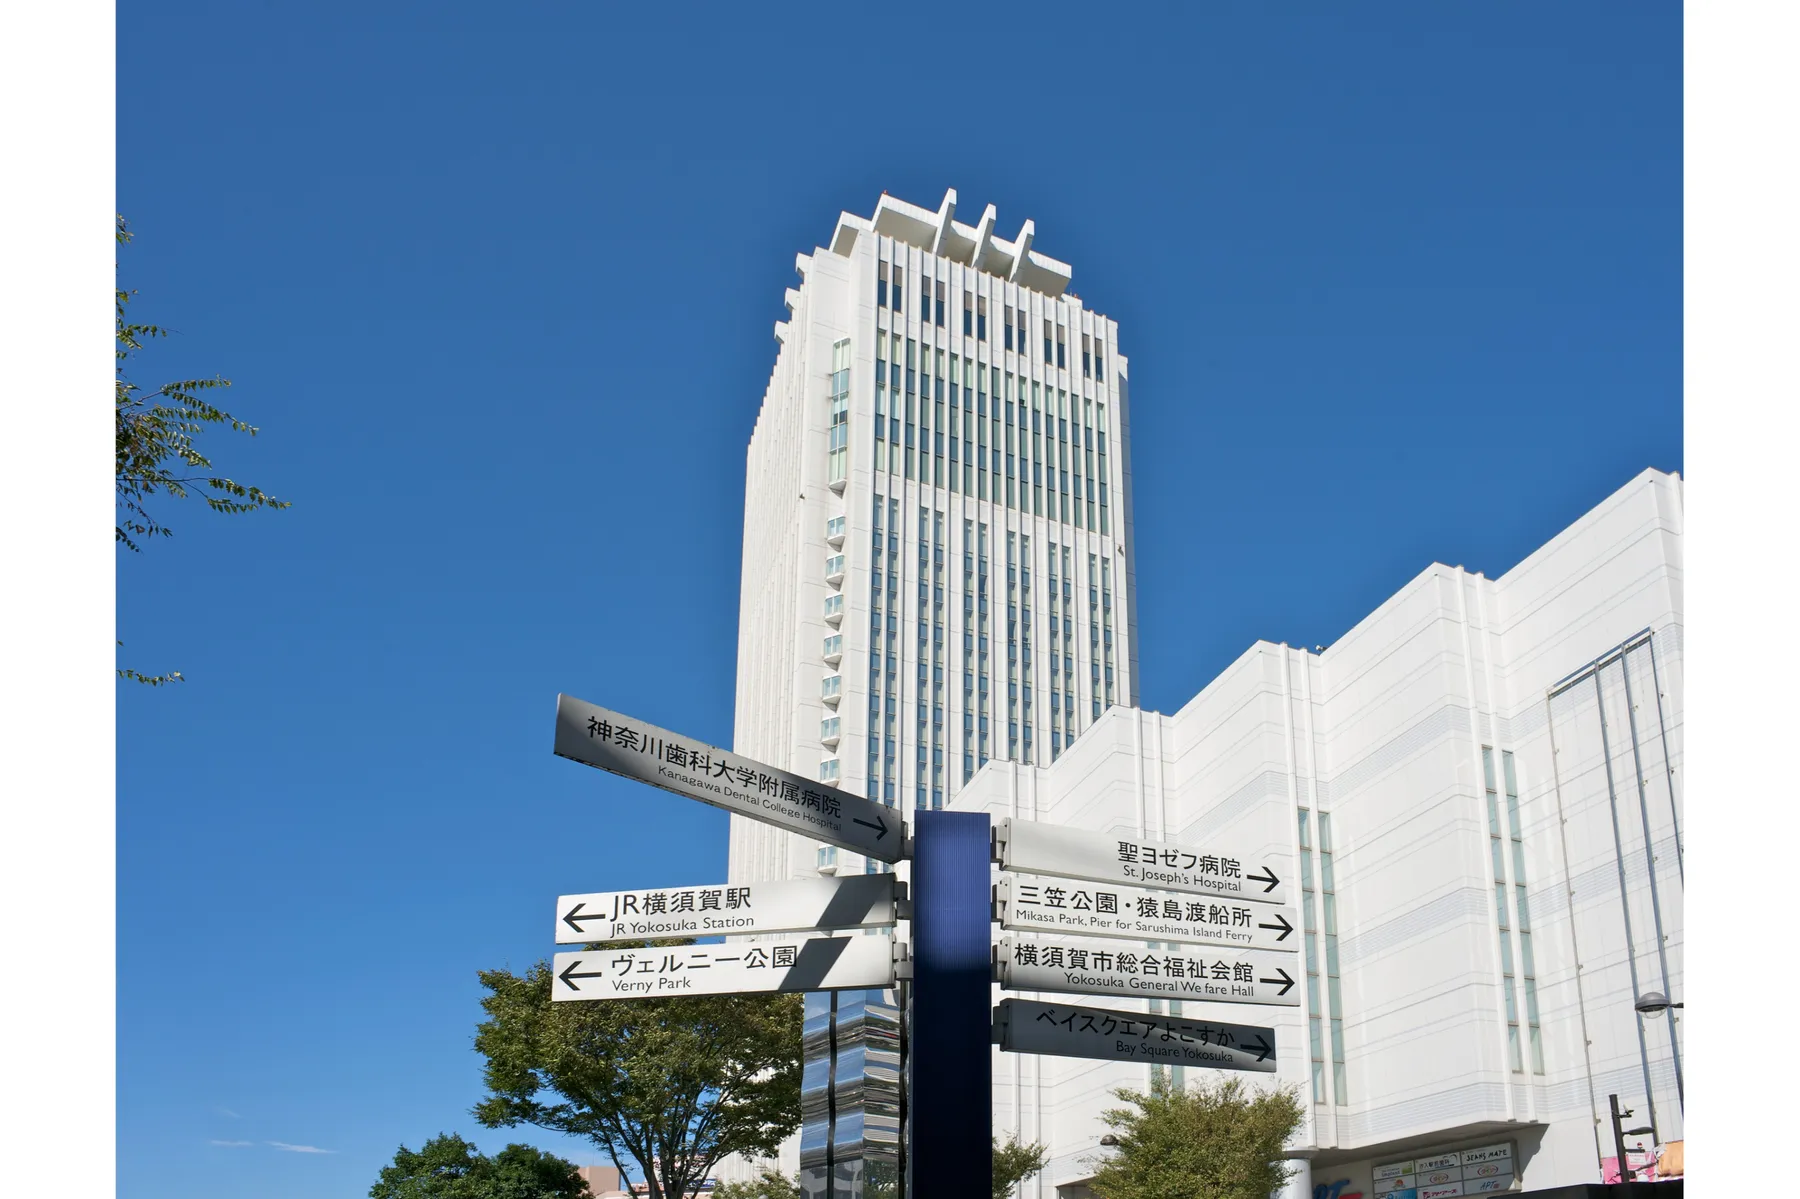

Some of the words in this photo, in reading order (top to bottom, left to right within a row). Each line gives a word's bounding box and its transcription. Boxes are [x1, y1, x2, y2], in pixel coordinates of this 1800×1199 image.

[586, 715, 841, 819] 神奈川歯科大学附属病院
[658, 765, 721, 793] Kanagawa
[724, 786, 759, 806] Dental
[762, 797, 800, 820] College
[803, 811, 842, 832] Hospital
[1118, 840, 1241, 879] 聖ヨゼフ病院
[1123, 865, 1139, 878] St.
[1141, 867, 1190, 886] Joseph's
[1194, 874, 1241, 892] Hospital
[610, 886, 751, 922] JR横須賀駅
[1018, 885, 1253, 928] 三笠公園・猿島渡船所
[610, 923, 626, 938] JR
[629, 918, 697, 934] Yokosuka
[703, 915, 755, 929] Station
[1016, 909, 1055, 924] Mikasa
[1059, 913, 1087, 927] Park,
[1090, 916, 1112, 929] Pier
[1116, 919, 1131, 931] for
[1135, 921, 1190, 936] Sarushima
[1193, 926, 1222, 939] Island
[1225, 928, 1253, 943] Ferry
[612, 945, 798, 978] ヴェルニー公園
[1014, 942, 1254, 984] 横須賀市総合福祉会館
[612, 978, 652, 993] Verny
[658, 976, 691, 989] Park
[1064, 972, 1125, 988] Yokosuka
[1129, 977, 1178, 992] General
[1231, 984, 1254, 997] Hall
[1036, 1009, 1235, 1047] ベイスクエアよこすか
[1116, 1040, 1136, 1056] Bay
[1140, 1042, 1180, 1058] Square
[1182, 1047, 1234, 1063] Yokosuka
[1466, 1152, 1486, 1161] JEANS
[1488, 1149, 1507, 1158] MATE
